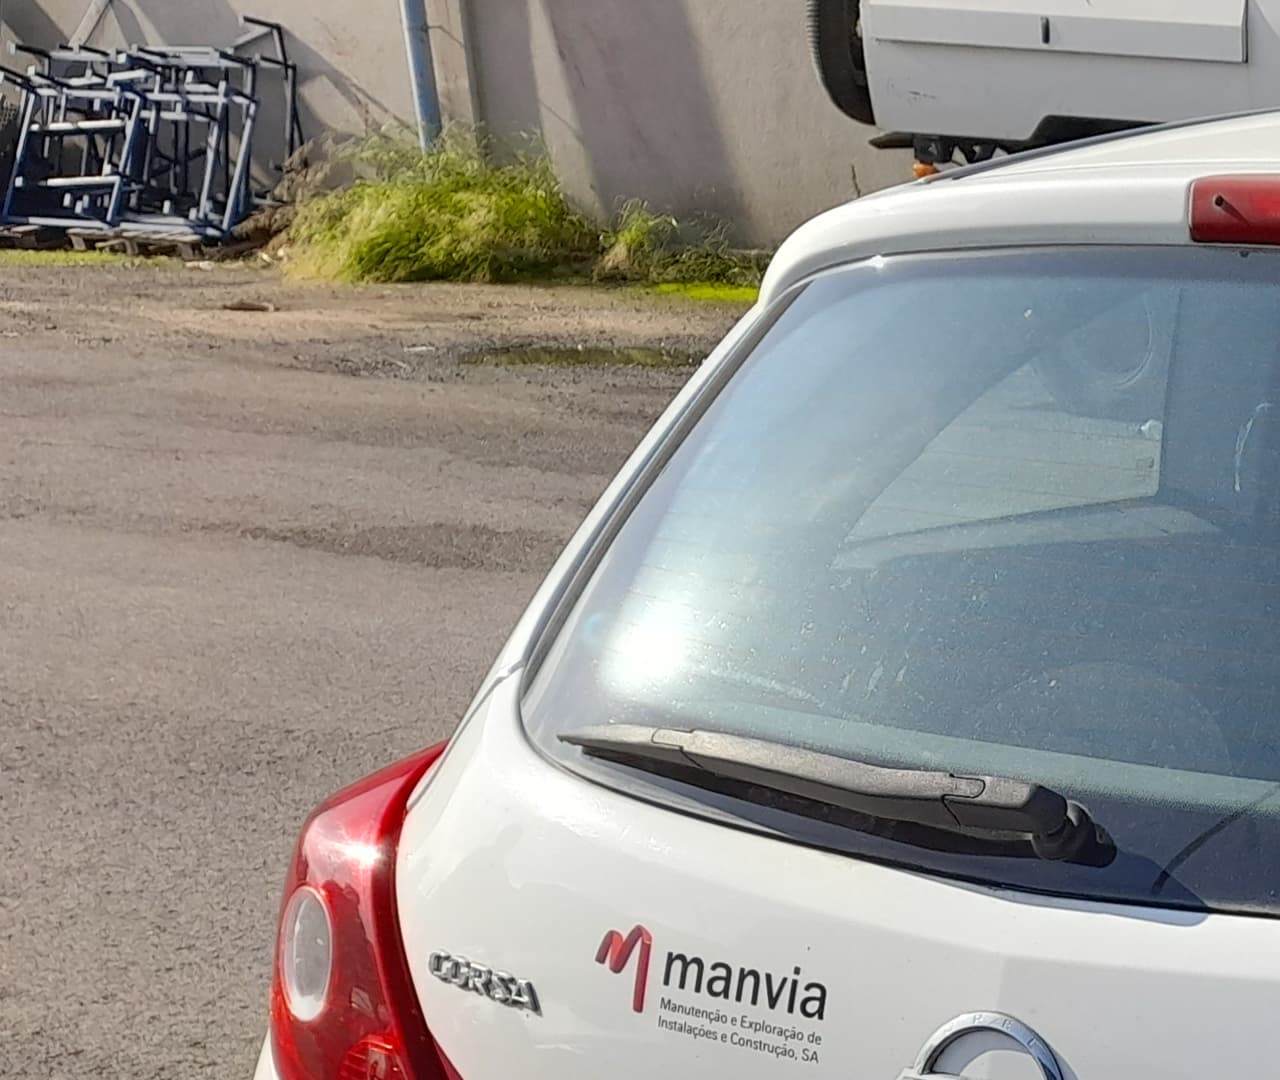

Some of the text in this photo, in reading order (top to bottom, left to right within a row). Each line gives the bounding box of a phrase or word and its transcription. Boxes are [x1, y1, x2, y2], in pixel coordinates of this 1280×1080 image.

[429, 949, 543, 1017] CORSA
[662, 950, 828, 1020] manvia
[657, 1016, 820, 1064] Instalações e Construção, SA
[660, 997, 822, 1046] Manutenção e Exploração de
